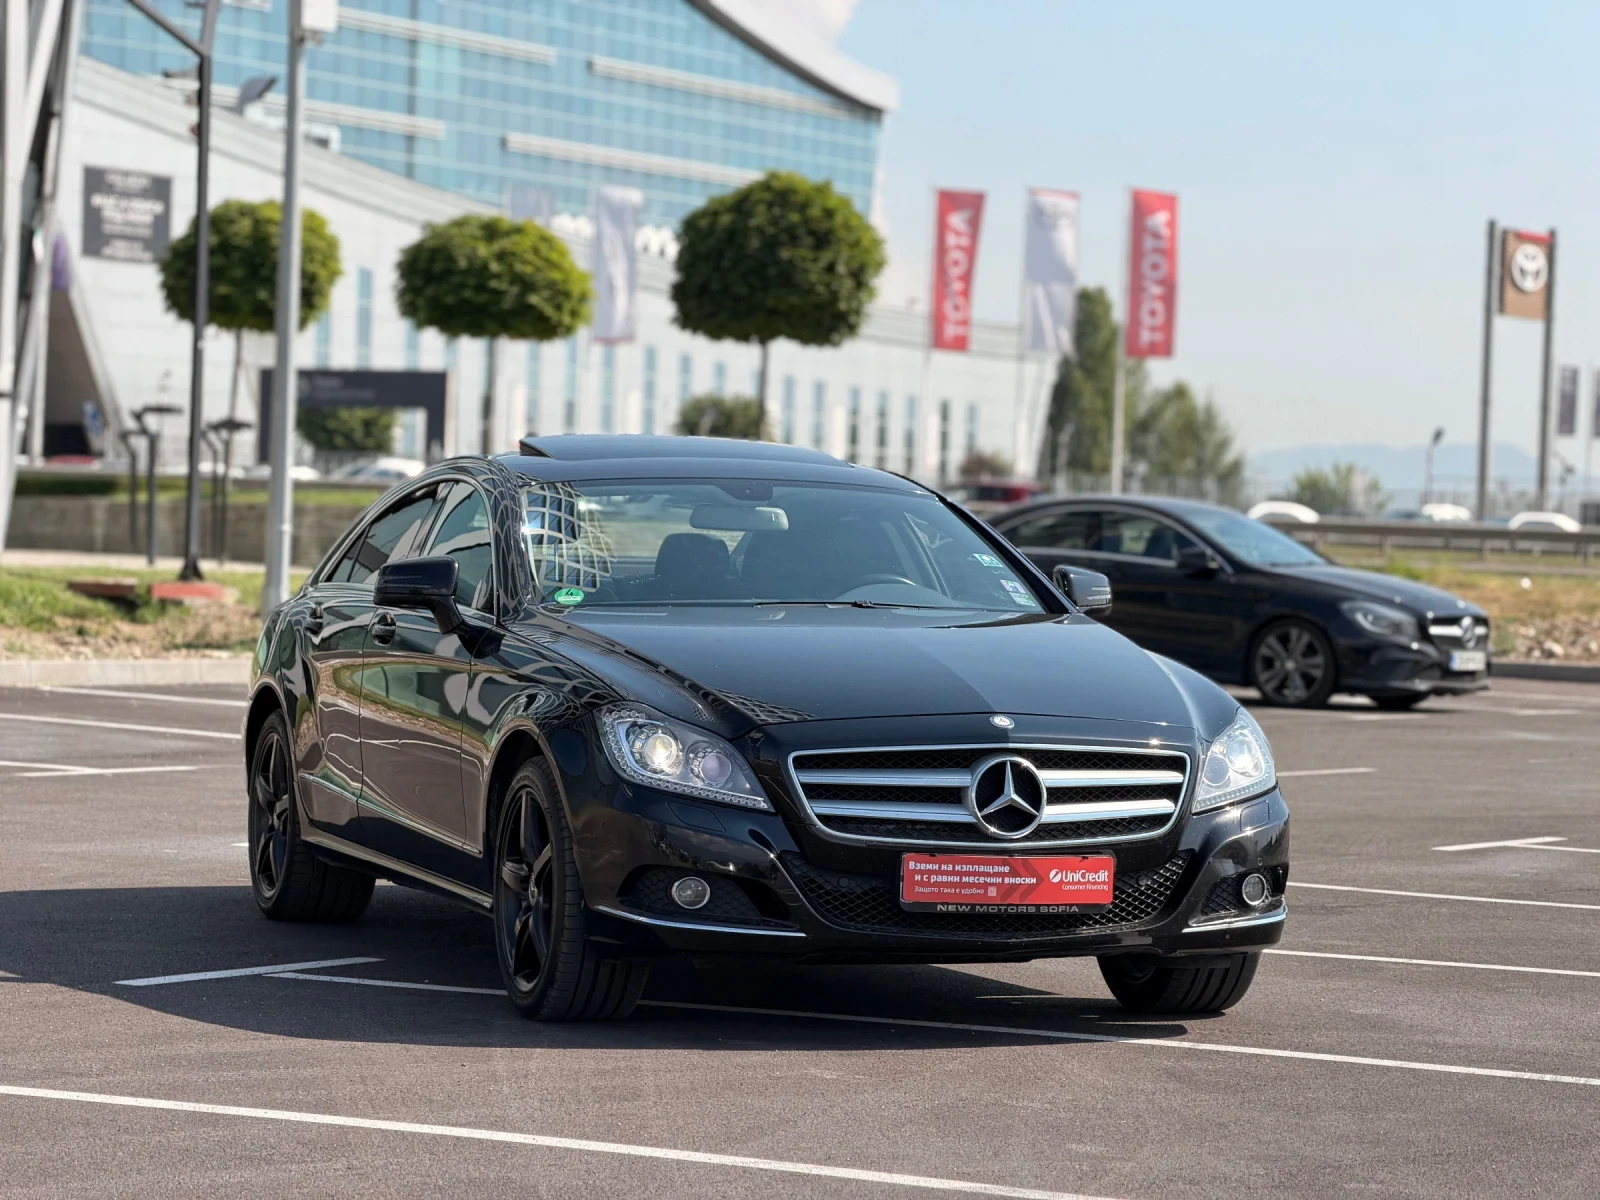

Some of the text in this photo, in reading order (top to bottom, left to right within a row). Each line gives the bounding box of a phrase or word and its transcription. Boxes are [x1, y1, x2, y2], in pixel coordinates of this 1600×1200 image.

[943, 208, 974, 342] TOYOTA
[1139, 209, 1172, 347] TOYOTA
[565, 588, 574, 596] 4
[909, 860, 1010, 874] Вземи на изплащане
[923, 874, 929, 882] с
[931, 874, 960, 884] равни
[962, 875, 1002, 884] месечни
[1004, 877, 1037, 885] вноски
[1062, 869, 1109, 882] UniCredit
[961, 887, 985, 895] удобно
[1086, 884, 1109, 892] Financing
[936, 904, 1079, 913] NEW MOTORS SOFIA
